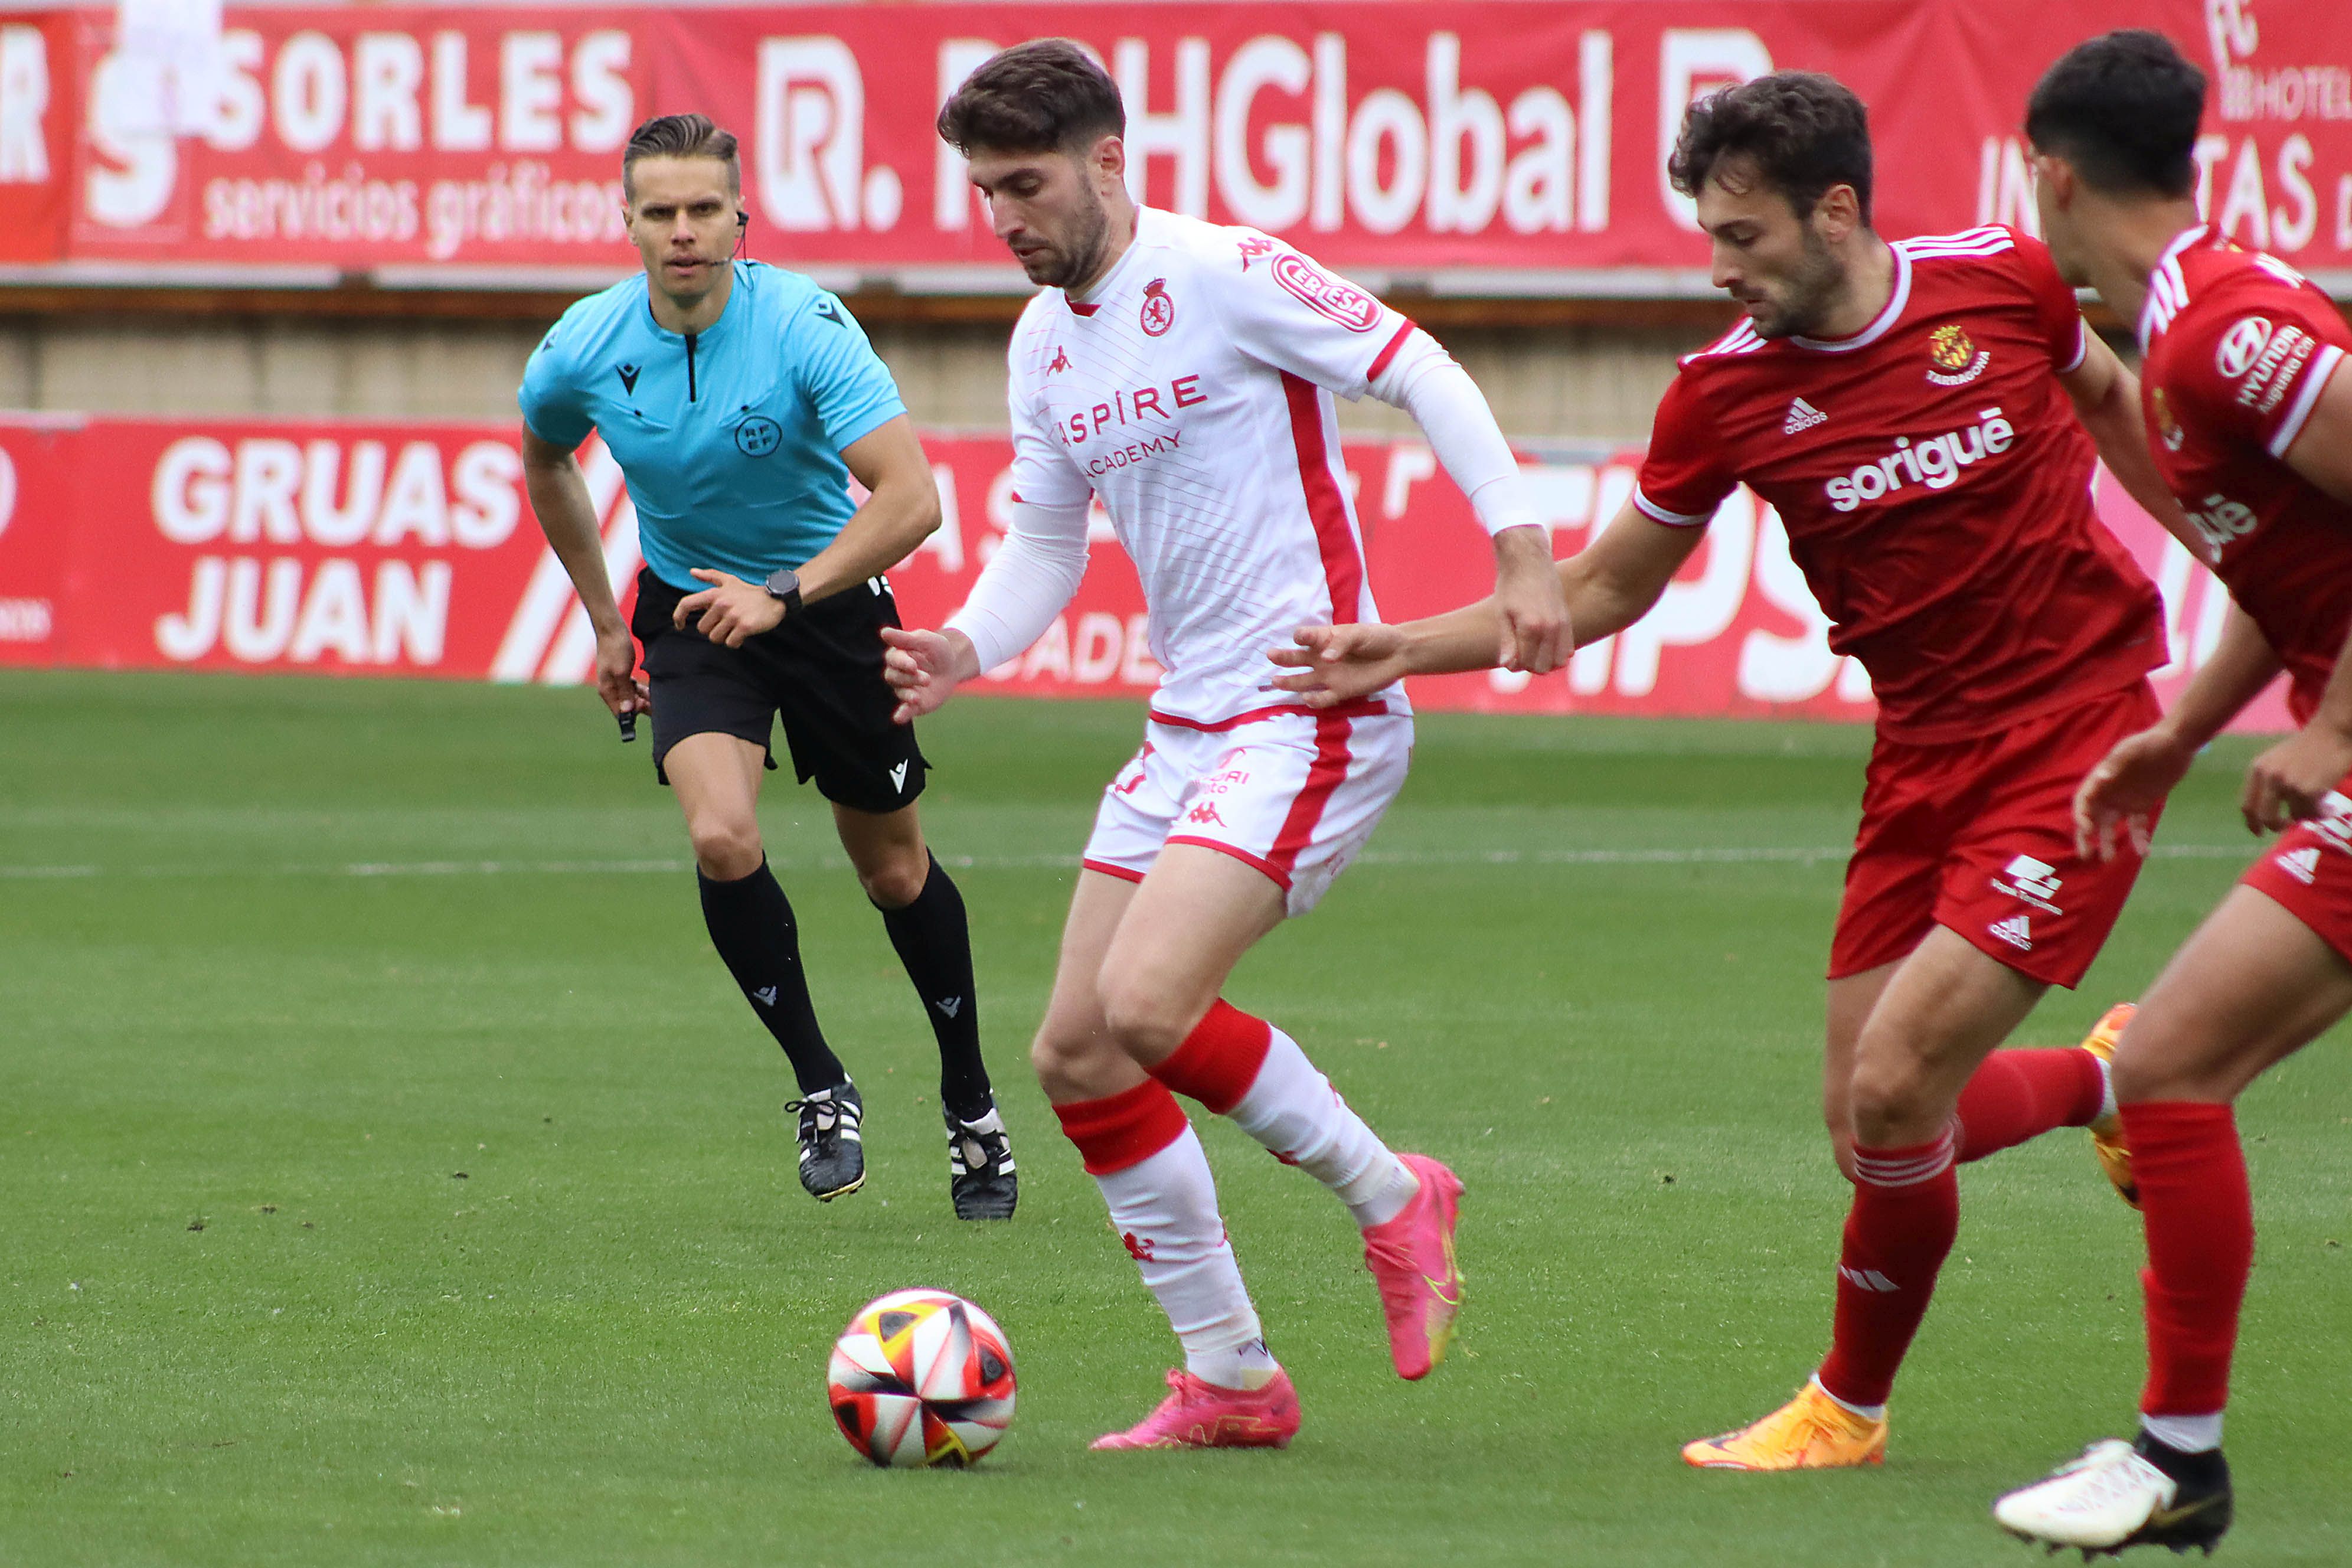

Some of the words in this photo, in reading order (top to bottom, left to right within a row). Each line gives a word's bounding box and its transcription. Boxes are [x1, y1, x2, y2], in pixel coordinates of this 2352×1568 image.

[202, 28, 635, 153] SORLES
[203, 161, 420, 241] servicios
[426, 160, 626, 260] gráficos
[2237, 325, 2304, 406] HYUNDAI
[1785, 411, 1828, 435] adidas
[152, 436, 522, 549] GRUAS
[154, 555, 453, 665] JUAN
